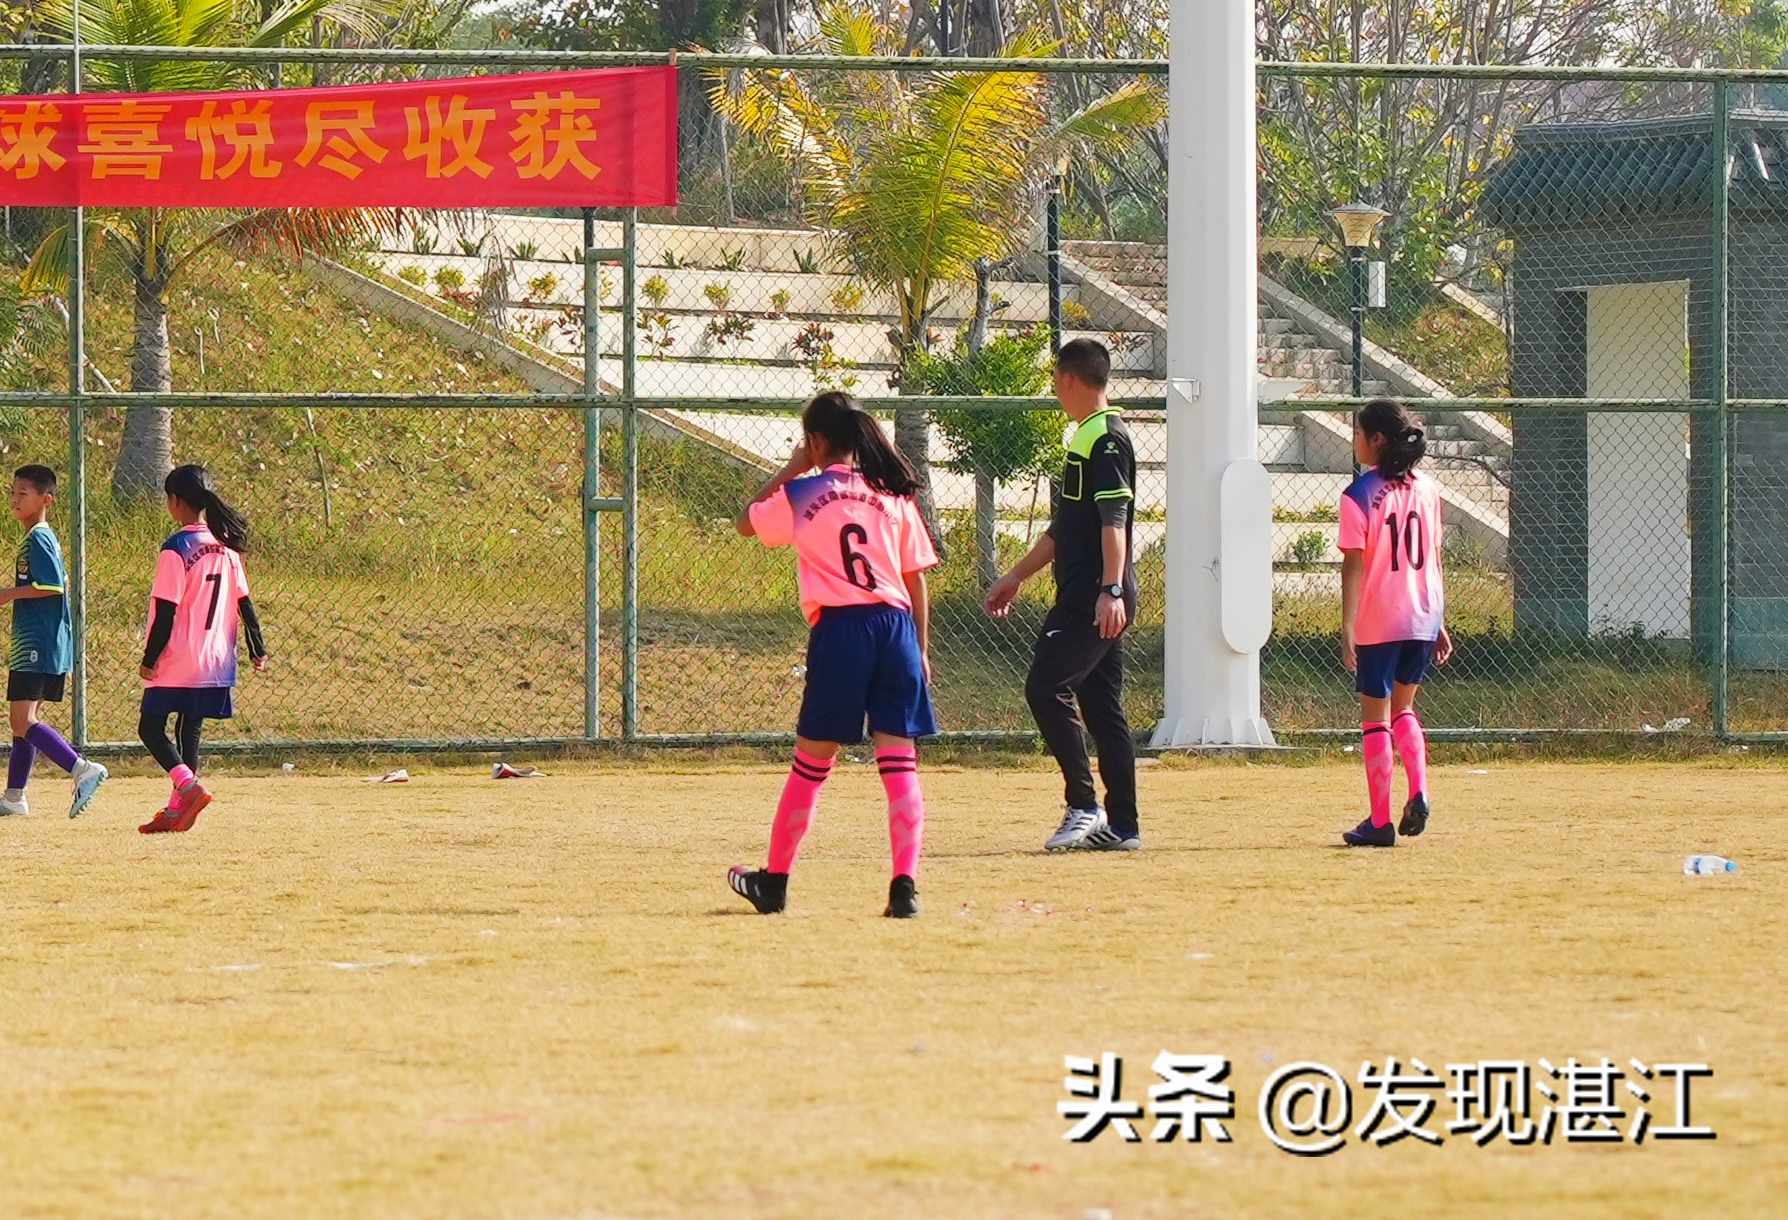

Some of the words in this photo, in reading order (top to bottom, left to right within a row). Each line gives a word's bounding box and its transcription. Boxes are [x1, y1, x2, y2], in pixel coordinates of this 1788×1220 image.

[840, 523, 877, 592] 6
[1385, 510, 1424, 571] 10
[205, 573, 222, 630] 7
